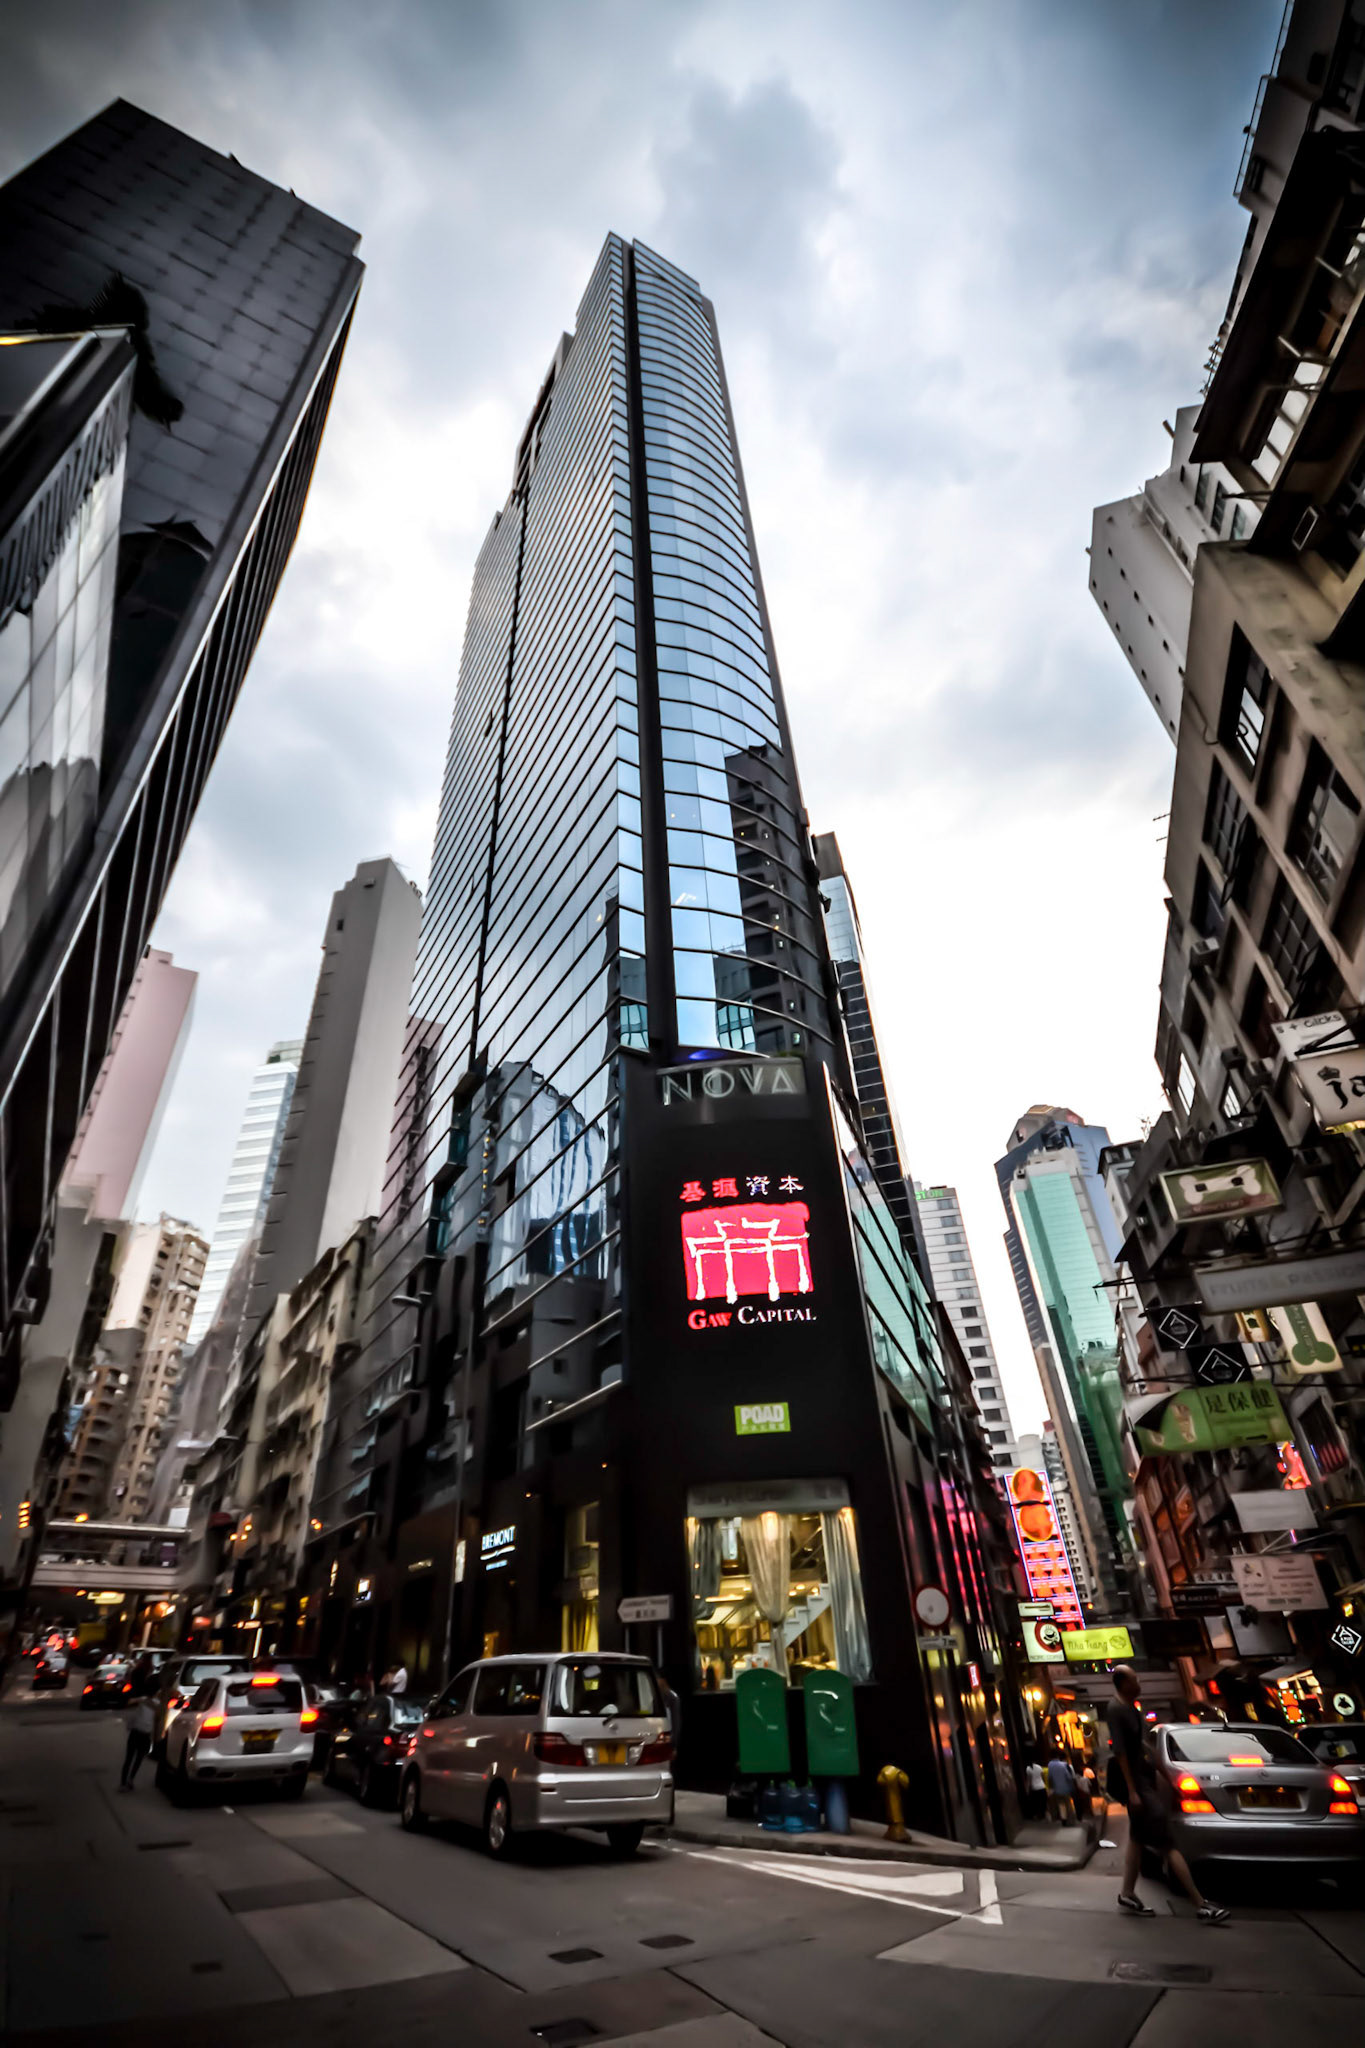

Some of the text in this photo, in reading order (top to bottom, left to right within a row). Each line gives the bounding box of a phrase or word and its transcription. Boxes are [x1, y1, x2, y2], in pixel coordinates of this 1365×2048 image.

[662, 1066, 798, 1106] NOVA
[737, 1305, 817, 1325] CAPITAL
[740, 1404, 784, 1425] POAD
[481, 1525, 516, 1551] BREMONT
